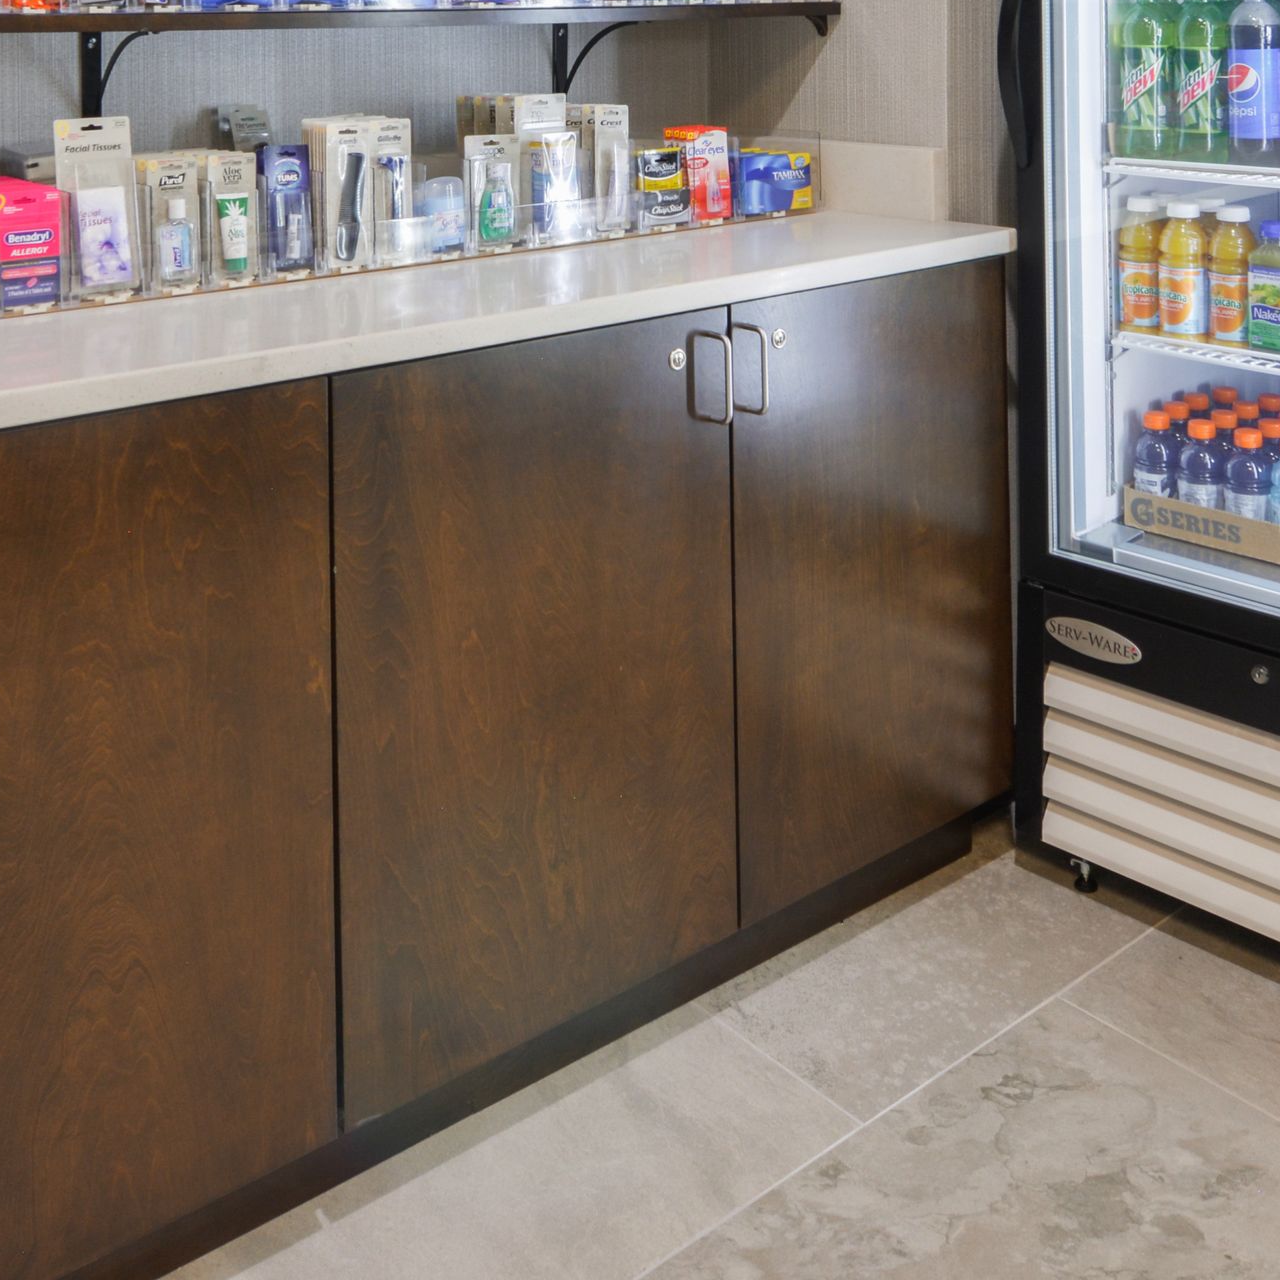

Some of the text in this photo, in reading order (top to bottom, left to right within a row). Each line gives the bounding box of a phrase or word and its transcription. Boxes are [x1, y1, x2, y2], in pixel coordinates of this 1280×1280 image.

[65, 143, 121, 154] Facial Tissues
[687, 144, 725, 156] Clear eyes
[223, 167, 242, 178] Aloe
[277, 173, 299, 183] TUMS
[772, 169, 806, 181] TAMPAX
[8, 230, 51, 244] Benadryl
[10, 246, 49, 257] ALLERGY
[1157, 507, 1241, 545] SERIES
[1048, 619, 1131, 658] SERV-WARE
